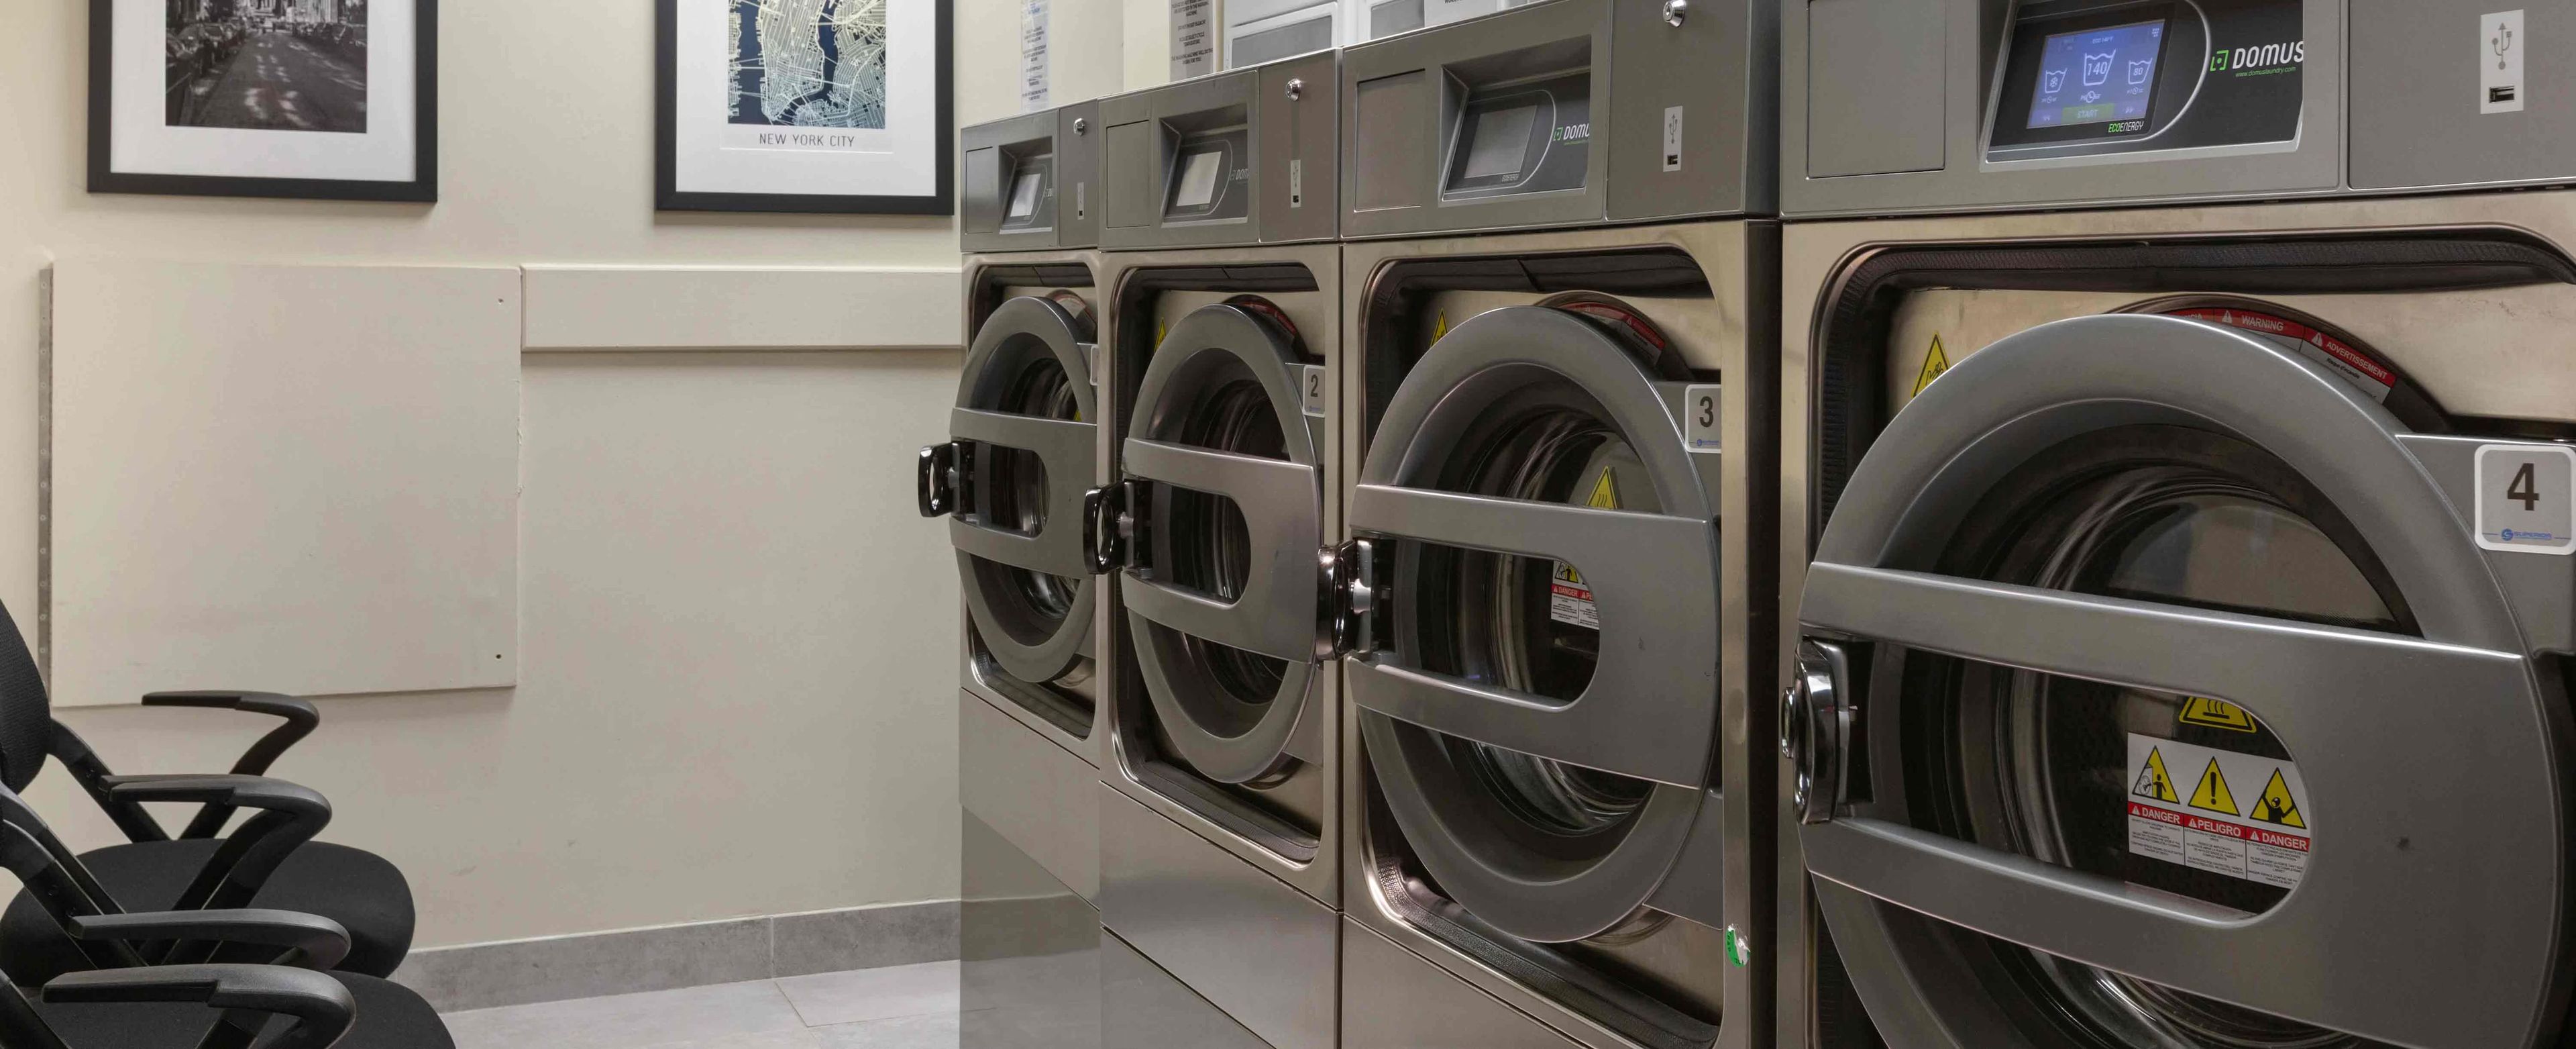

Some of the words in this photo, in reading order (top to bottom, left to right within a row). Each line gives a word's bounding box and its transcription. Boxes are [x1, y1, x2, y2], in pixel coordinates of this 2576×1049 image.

[2233, 40, 2304, 69] DOMUS
[2088, 62, 2108, 76] 140
[2133, 67, 2143, 76] 80
[2077, 109, 2098, 119] START
[2108, 121, 2145, 134] ECOENERGY
[759, 133, 787, 145] NEW
[792, 134, 824, 146] YORK
[829, 135, 855, 147] CITY
[2241, 314, 2284, 332] WARNING
[2326, 341, 2388, 380] ADVERTISSEMENT
[1310, 374, 1319, 397] 2
[1699, 396, 1714, 428] 3
[2507, 462, 2540, 511] 4
[1558, 587, 1578, 597] DANGER
[2141, 807, 2180, 825] DANGER
[2198, 819, 2241, 837] PELIGRO
[2261, 832, 2307, 850] DANGER
